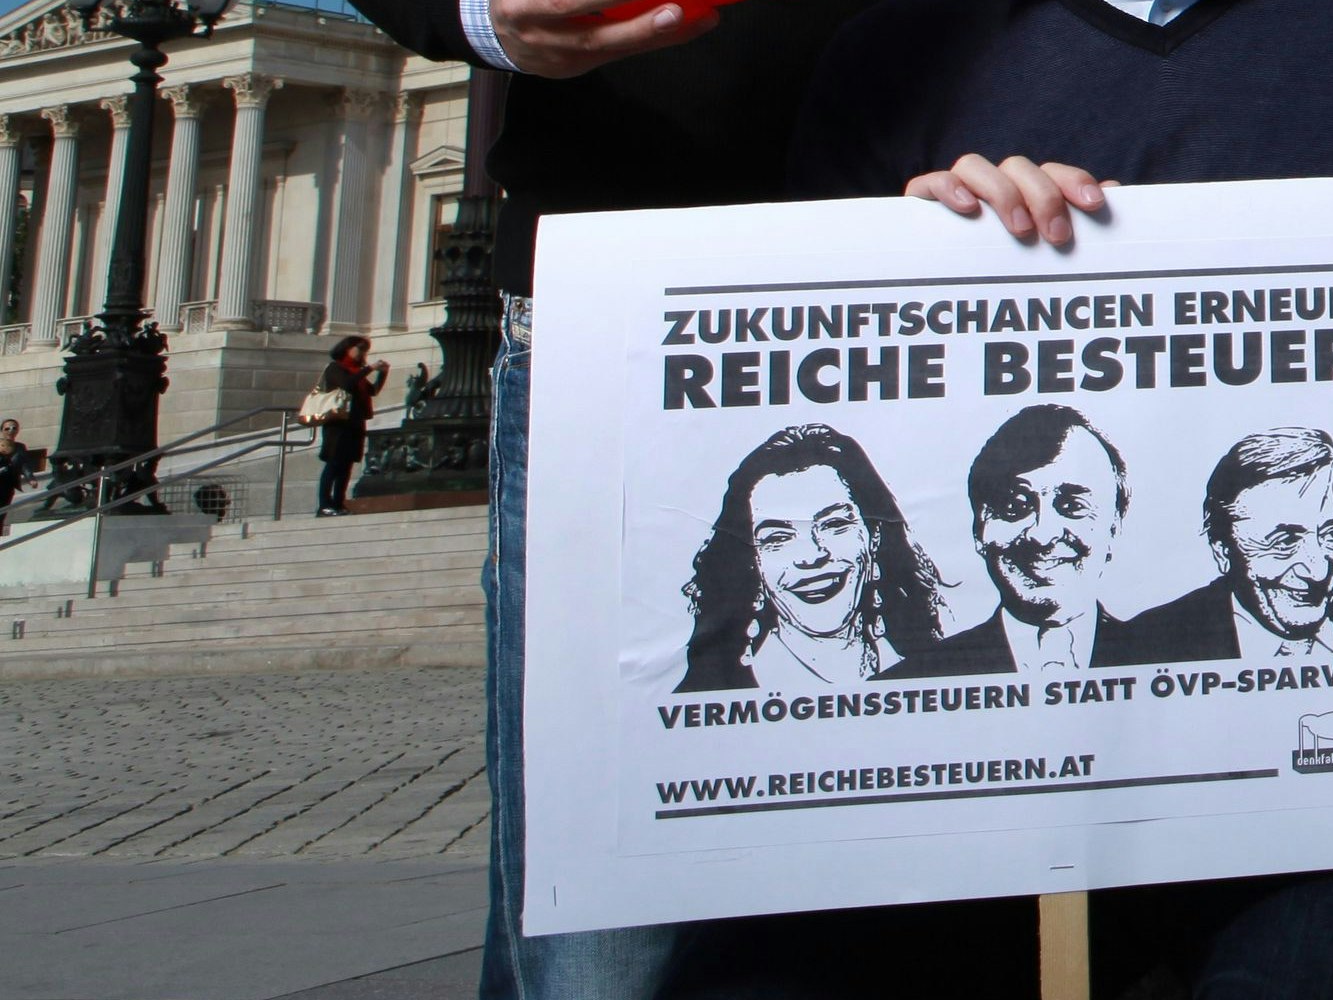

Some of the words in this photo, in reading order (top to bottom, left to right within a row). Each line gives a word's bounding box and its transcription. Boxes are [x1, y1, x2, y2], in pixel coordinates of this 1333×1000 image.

[662, 294, 1153, 346] ZUKUNFTSCHANCEN
[664, 342, 945, 410] REICHE
[658, 682, 1030, 730] VERMÖGENSSTEUERN
[1045, 677, 1137, 706] STATT
[656, 754, 1096, 804] WWW.REICHEBESTEUERN.AT
